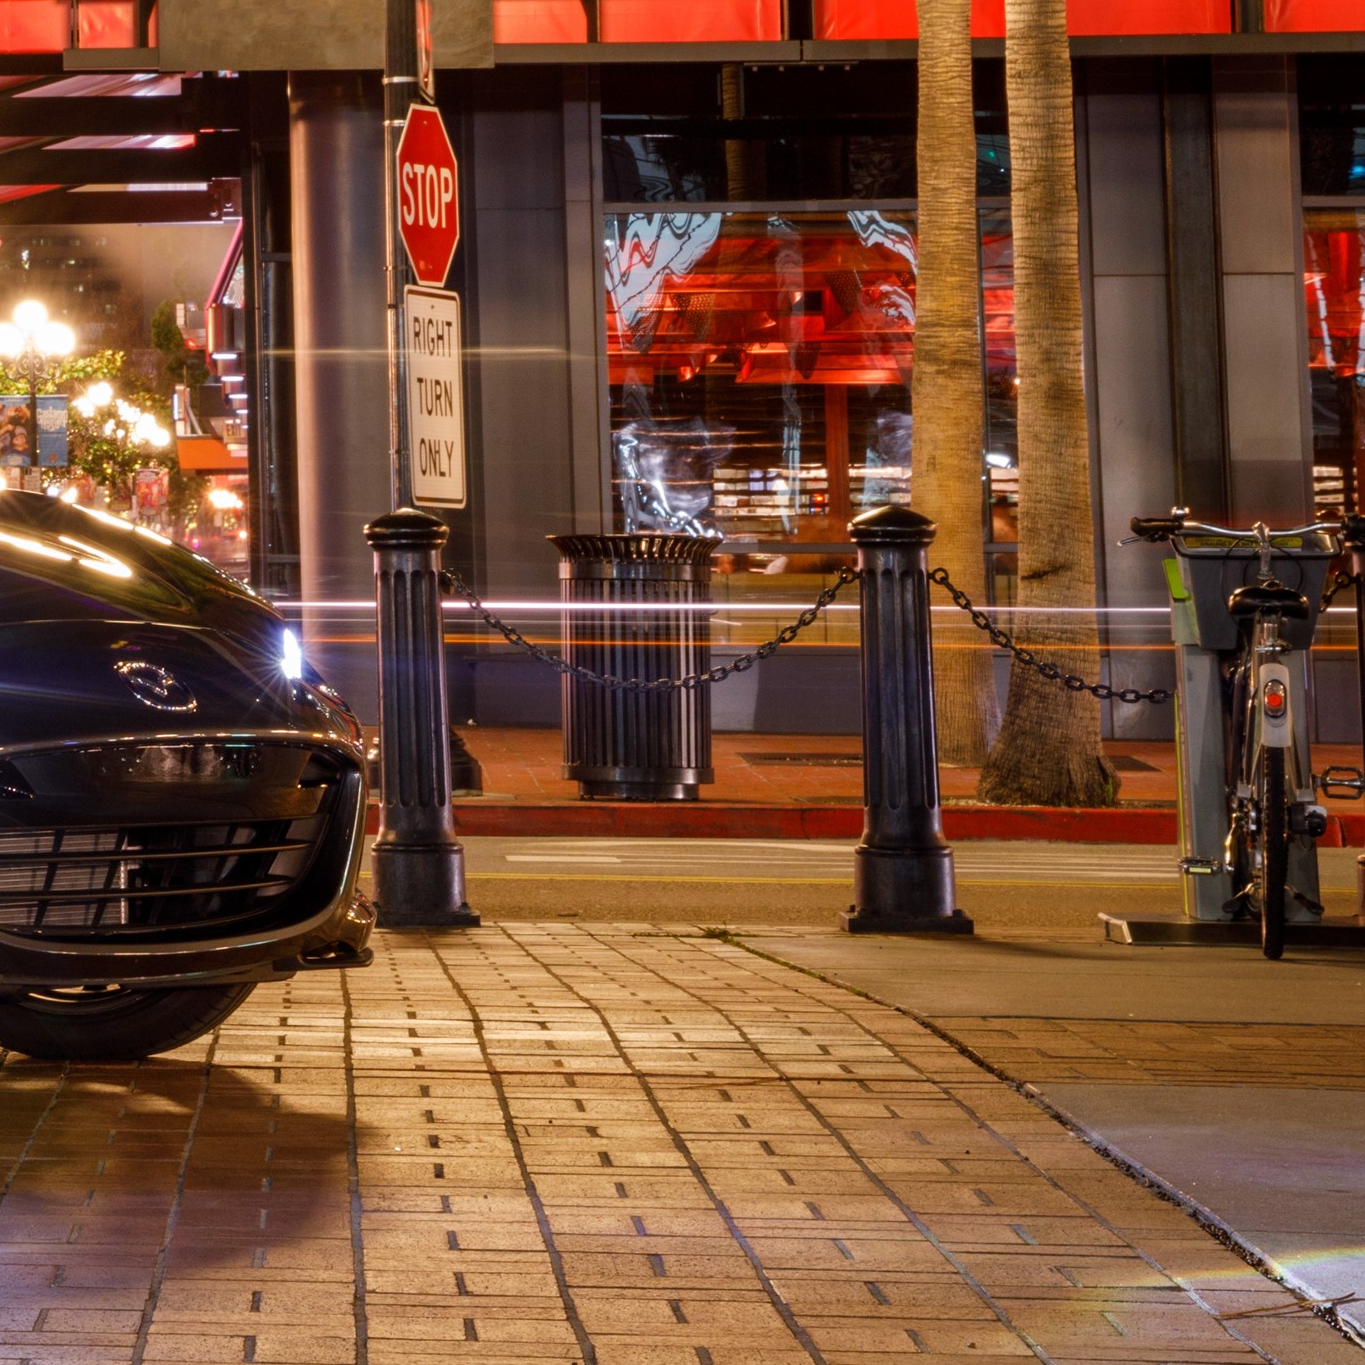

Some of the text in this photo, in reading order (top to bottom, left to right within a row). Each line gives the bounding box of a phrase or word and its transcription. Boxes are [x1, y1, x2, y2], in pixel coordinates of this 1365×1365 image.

[402, 162, 453, 229] STOP
[413, 317, 453, 358] RIGHT
[417, 377, 453, 417] TURN
[419, 437, 454, 478] ONLY
